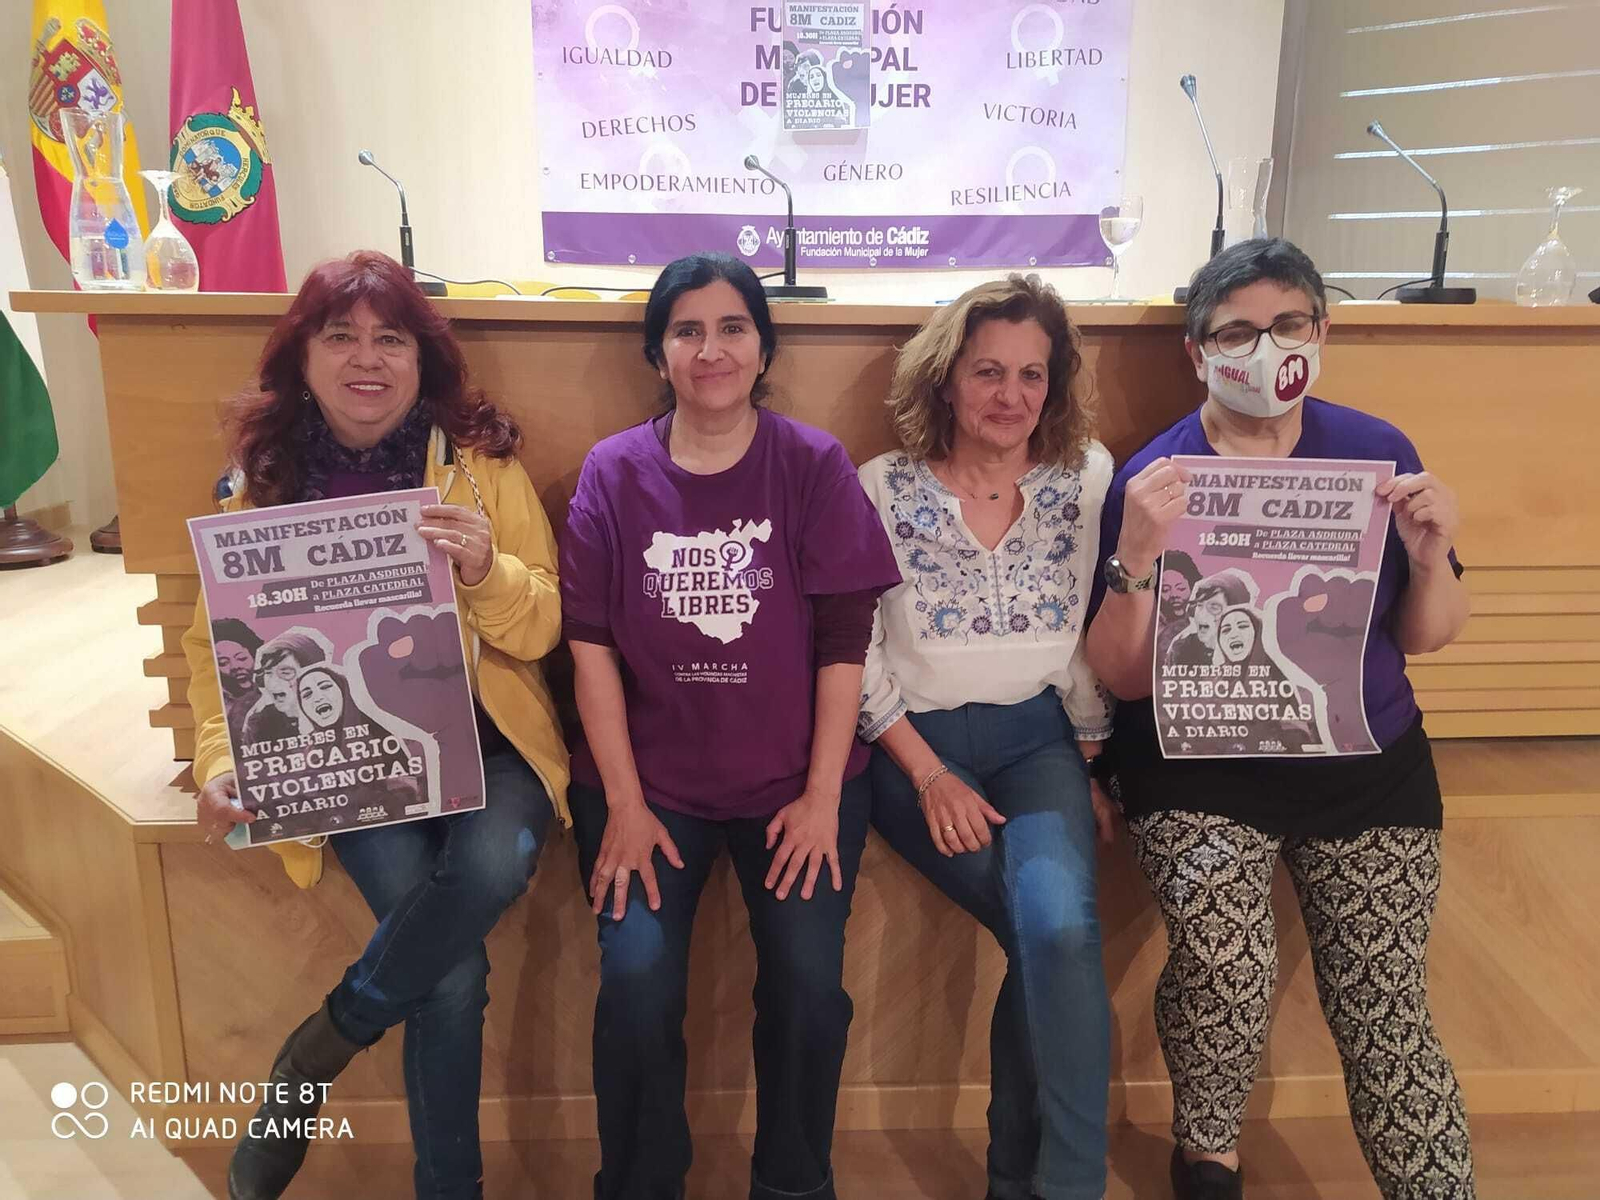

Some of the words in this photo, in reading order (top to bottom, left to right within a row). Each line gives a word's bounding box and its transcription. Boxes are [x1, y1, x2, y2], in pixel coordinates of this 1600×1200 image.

[750, 3, 923, 34] FUIÓN
[790, 13, 812, 26] 8M
[562, 46, 672, 68] IGUALDAD
[1007, 48, 1103, 69] LIBERTAD
[741, 82, 777, 106] DE
[786, 99, 842, 108] PRECARIO
[786, 108, 850, 117] VIOLENCIAS
[983, 103, 1077, 130] VICTORIA
[582, 114, 696, 139] DERECHOS
[823, 160, 903, 181] GÉNERO
[580, 172, 775, 196] EMPODERAMIENTO
[951, 181, 1071, 206] RESILIENCIA
[766, 226, 862, 248] Ayntamiento
[866, 227, 883, 245] de
[887, 226, 929, 245] Cádiz
[800, 246, 842, 257] Fundación
[844, 246, 881, 258] Municipal
[883, 246, 894, 257] de
[895, 246, 903, 257] la
[905, 246, 928, 259] Mujer
[1278, 357, 1304, 391] 8M
[1189, 471, 1363, 492] MANIFESTACIÓN
[1186, 491, 1243, 517] 8M
[1261, 493, 1354, 520] CÁDIZ
[214, 505, 408, 549] MANIFESTACIÓN
[1256, 529, 1269, 538] De
[1270, 529, 1306, 540] PLAZA
[1198, 532, 1252, 547] 18.30H
[1262, 540, 1297, 551] PLAZA
[1300, 541, 1355, 552] CATEDRAL
[222, 545, 285, 579] 8M
[307, 533, 406, 566] CÁDIZ
[671, 546, 717, 569] NOS
[310, 579, 325, 589] De
[327, 572, 365, 587] PLAZA
[313, 593, 320, 601] a
[321, 584, 362, 600] PLAZA
[363, 577, 424, 594] CATEDRAL
[642, 567, 774, 598] QUEREMOS
[247, 586, 309, 608] 18.30H
[314, 601, 353, 613] Recuerda
[355, 597, 378, 607] llevar
[661, 593, 751, 618] LIBRES
[691, 662, 748, 671] MARCHA
[1161, 664, 1242, 678] MUJERES
[1248, 664, 1271, 677] EN
[1162, 680, 1296, 699] PRECARIO
[1162, 703, 1313, 721] VIOLENCIAS
[240, 728, 336, 758] MUJERES
[342, 723, 370, 740] EN
[1167, 726, 1180, 738] A
[1185, 725, 1249, 738] DIARIO
[243, 735, 401, 781] PRECARIO
[247, 756, 423, 803] VIOLENCIAS
[256, 809, 269, 821] A
[276, 793, 349, 818] DIARIO
